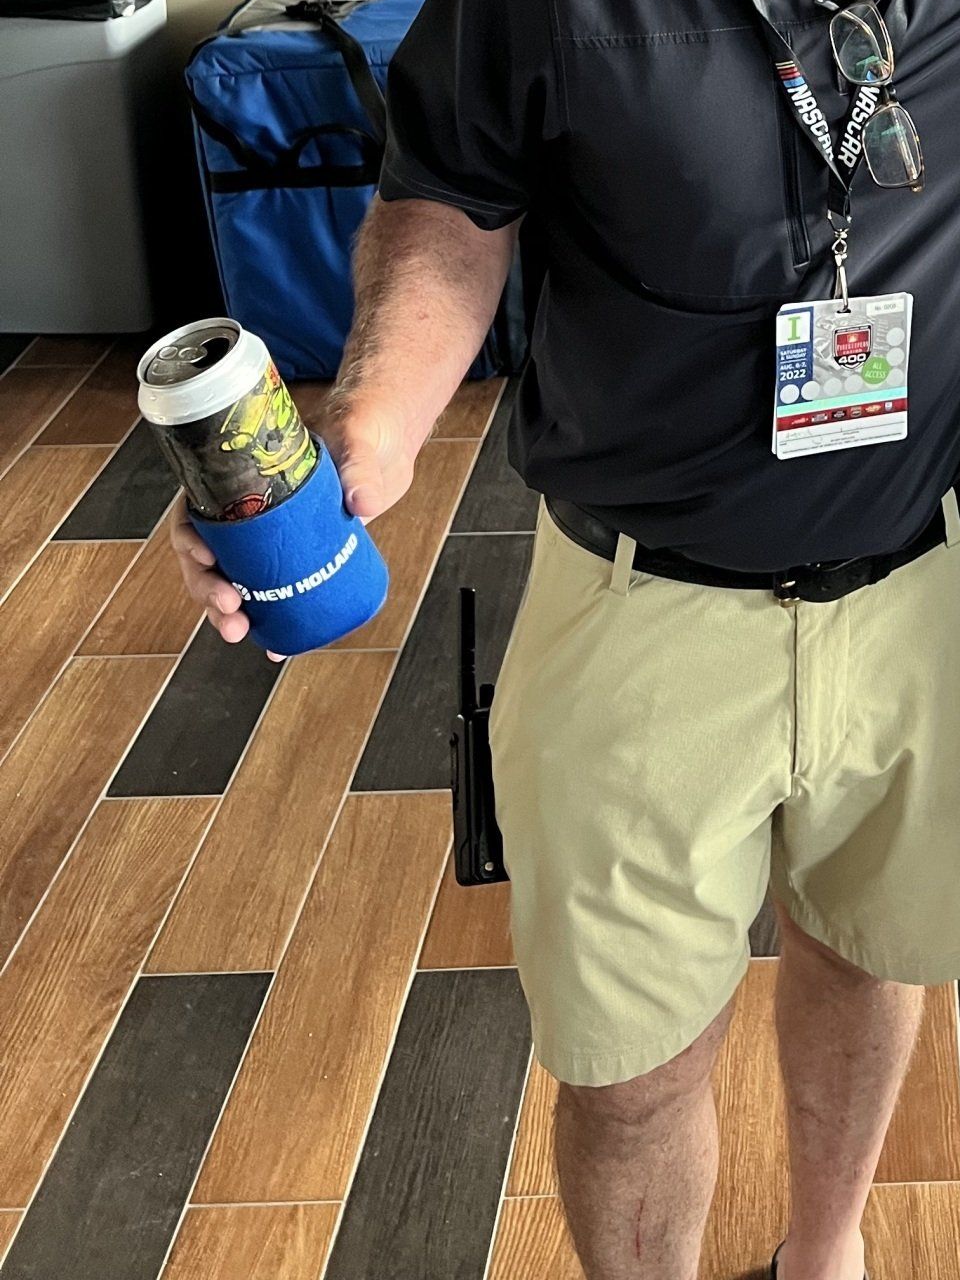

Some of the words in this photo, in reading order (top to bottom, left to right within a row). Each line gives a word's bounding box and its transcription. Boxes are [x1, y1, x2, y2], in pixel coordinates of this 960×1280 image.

[780, 348, 808, 357] SATURDAY
[838, 353, 867, 364] 400
[780, 363, 794, 371] AUG.
[872, 362, 882, 370] ALL
[779, 369, 807, 381] 2022
[864, 371, 887, 379] ACCESS
[252, 584, 294, 602] NEW
[295, 533, 358, 594] HOLLAND
